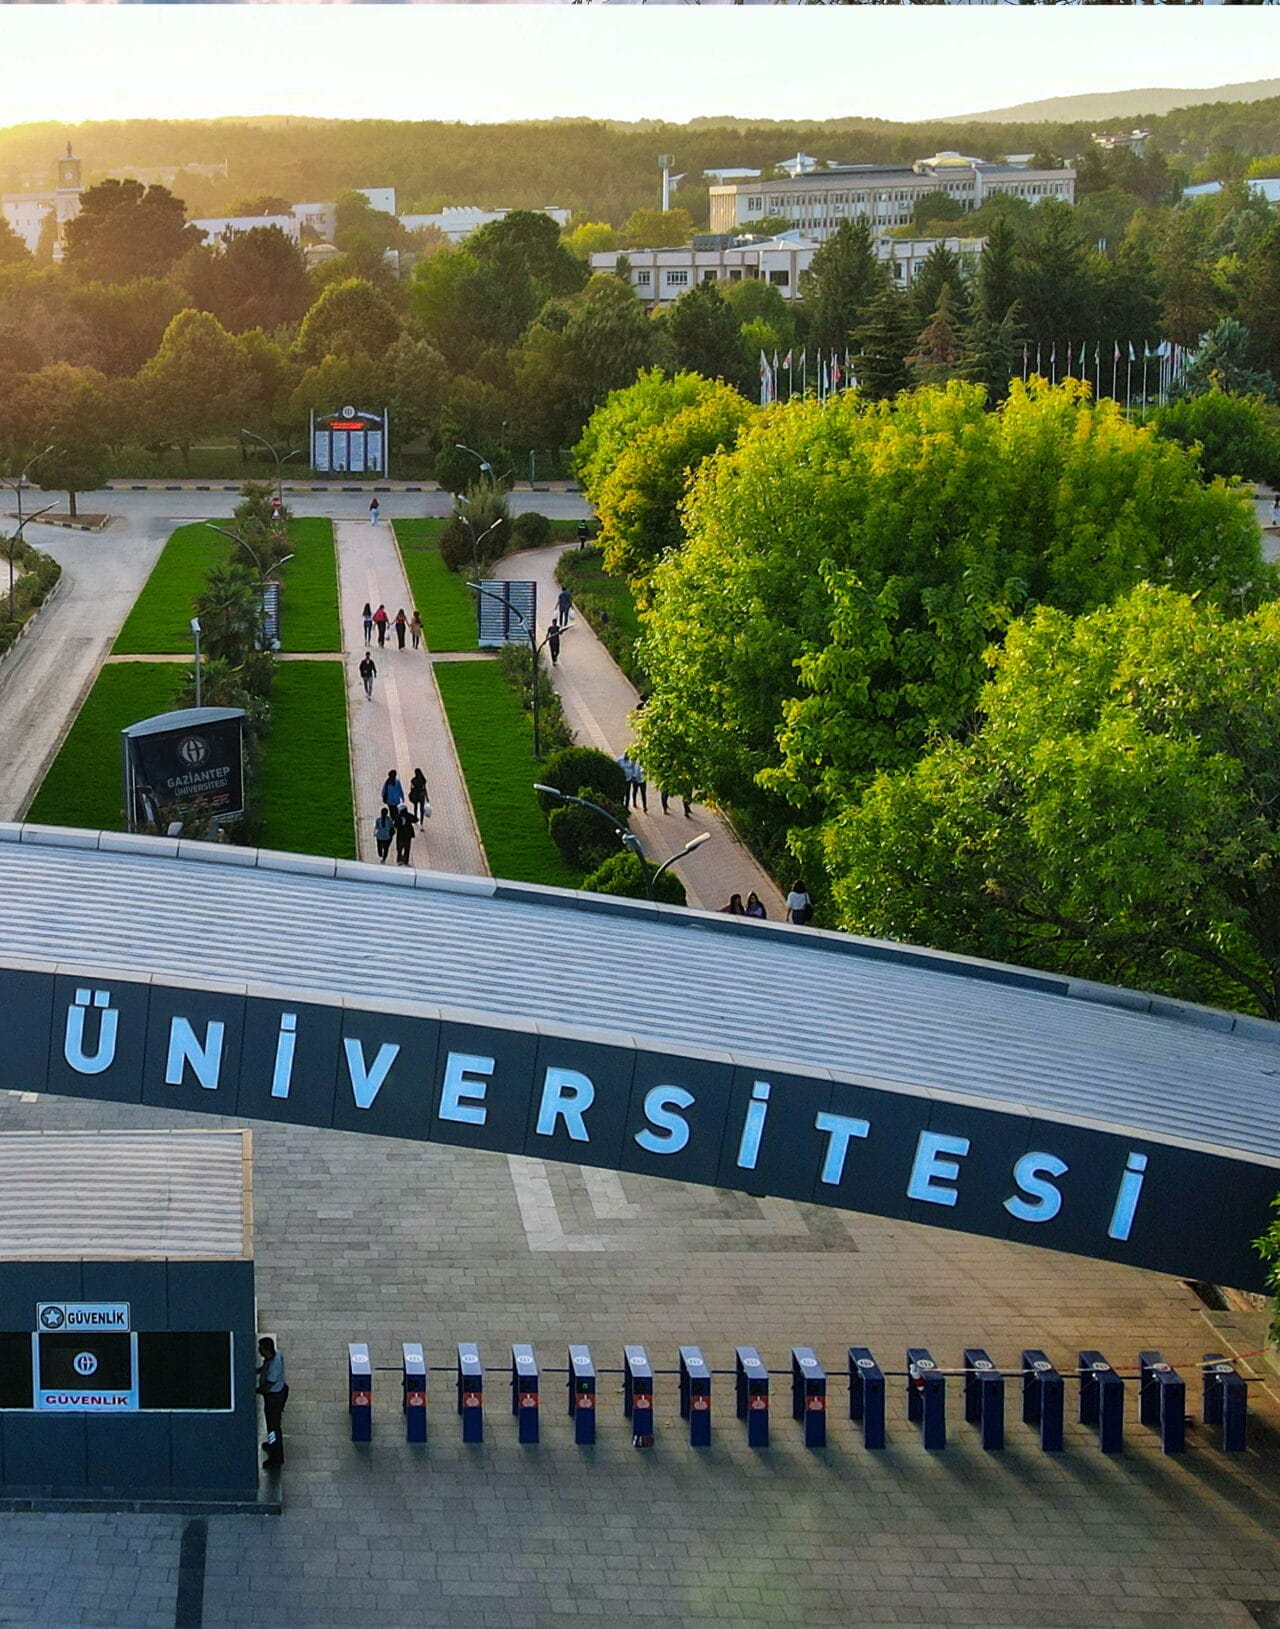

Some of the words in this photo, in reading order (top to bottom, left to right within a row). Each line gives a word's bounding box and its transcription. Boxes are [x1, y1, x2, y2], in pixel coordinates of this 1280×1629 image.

[167, 766, 230, 788] GAZİANTEP
[174, 778, 228, 797] ÜNİVERSİTESİ
[63, 988, 1149, 1241] ÜNİVERSİTESİ
[67, 1309, 125, 1325] GÜVENLİK
[45, 1393, 128, 1406] GÜVENLİK
